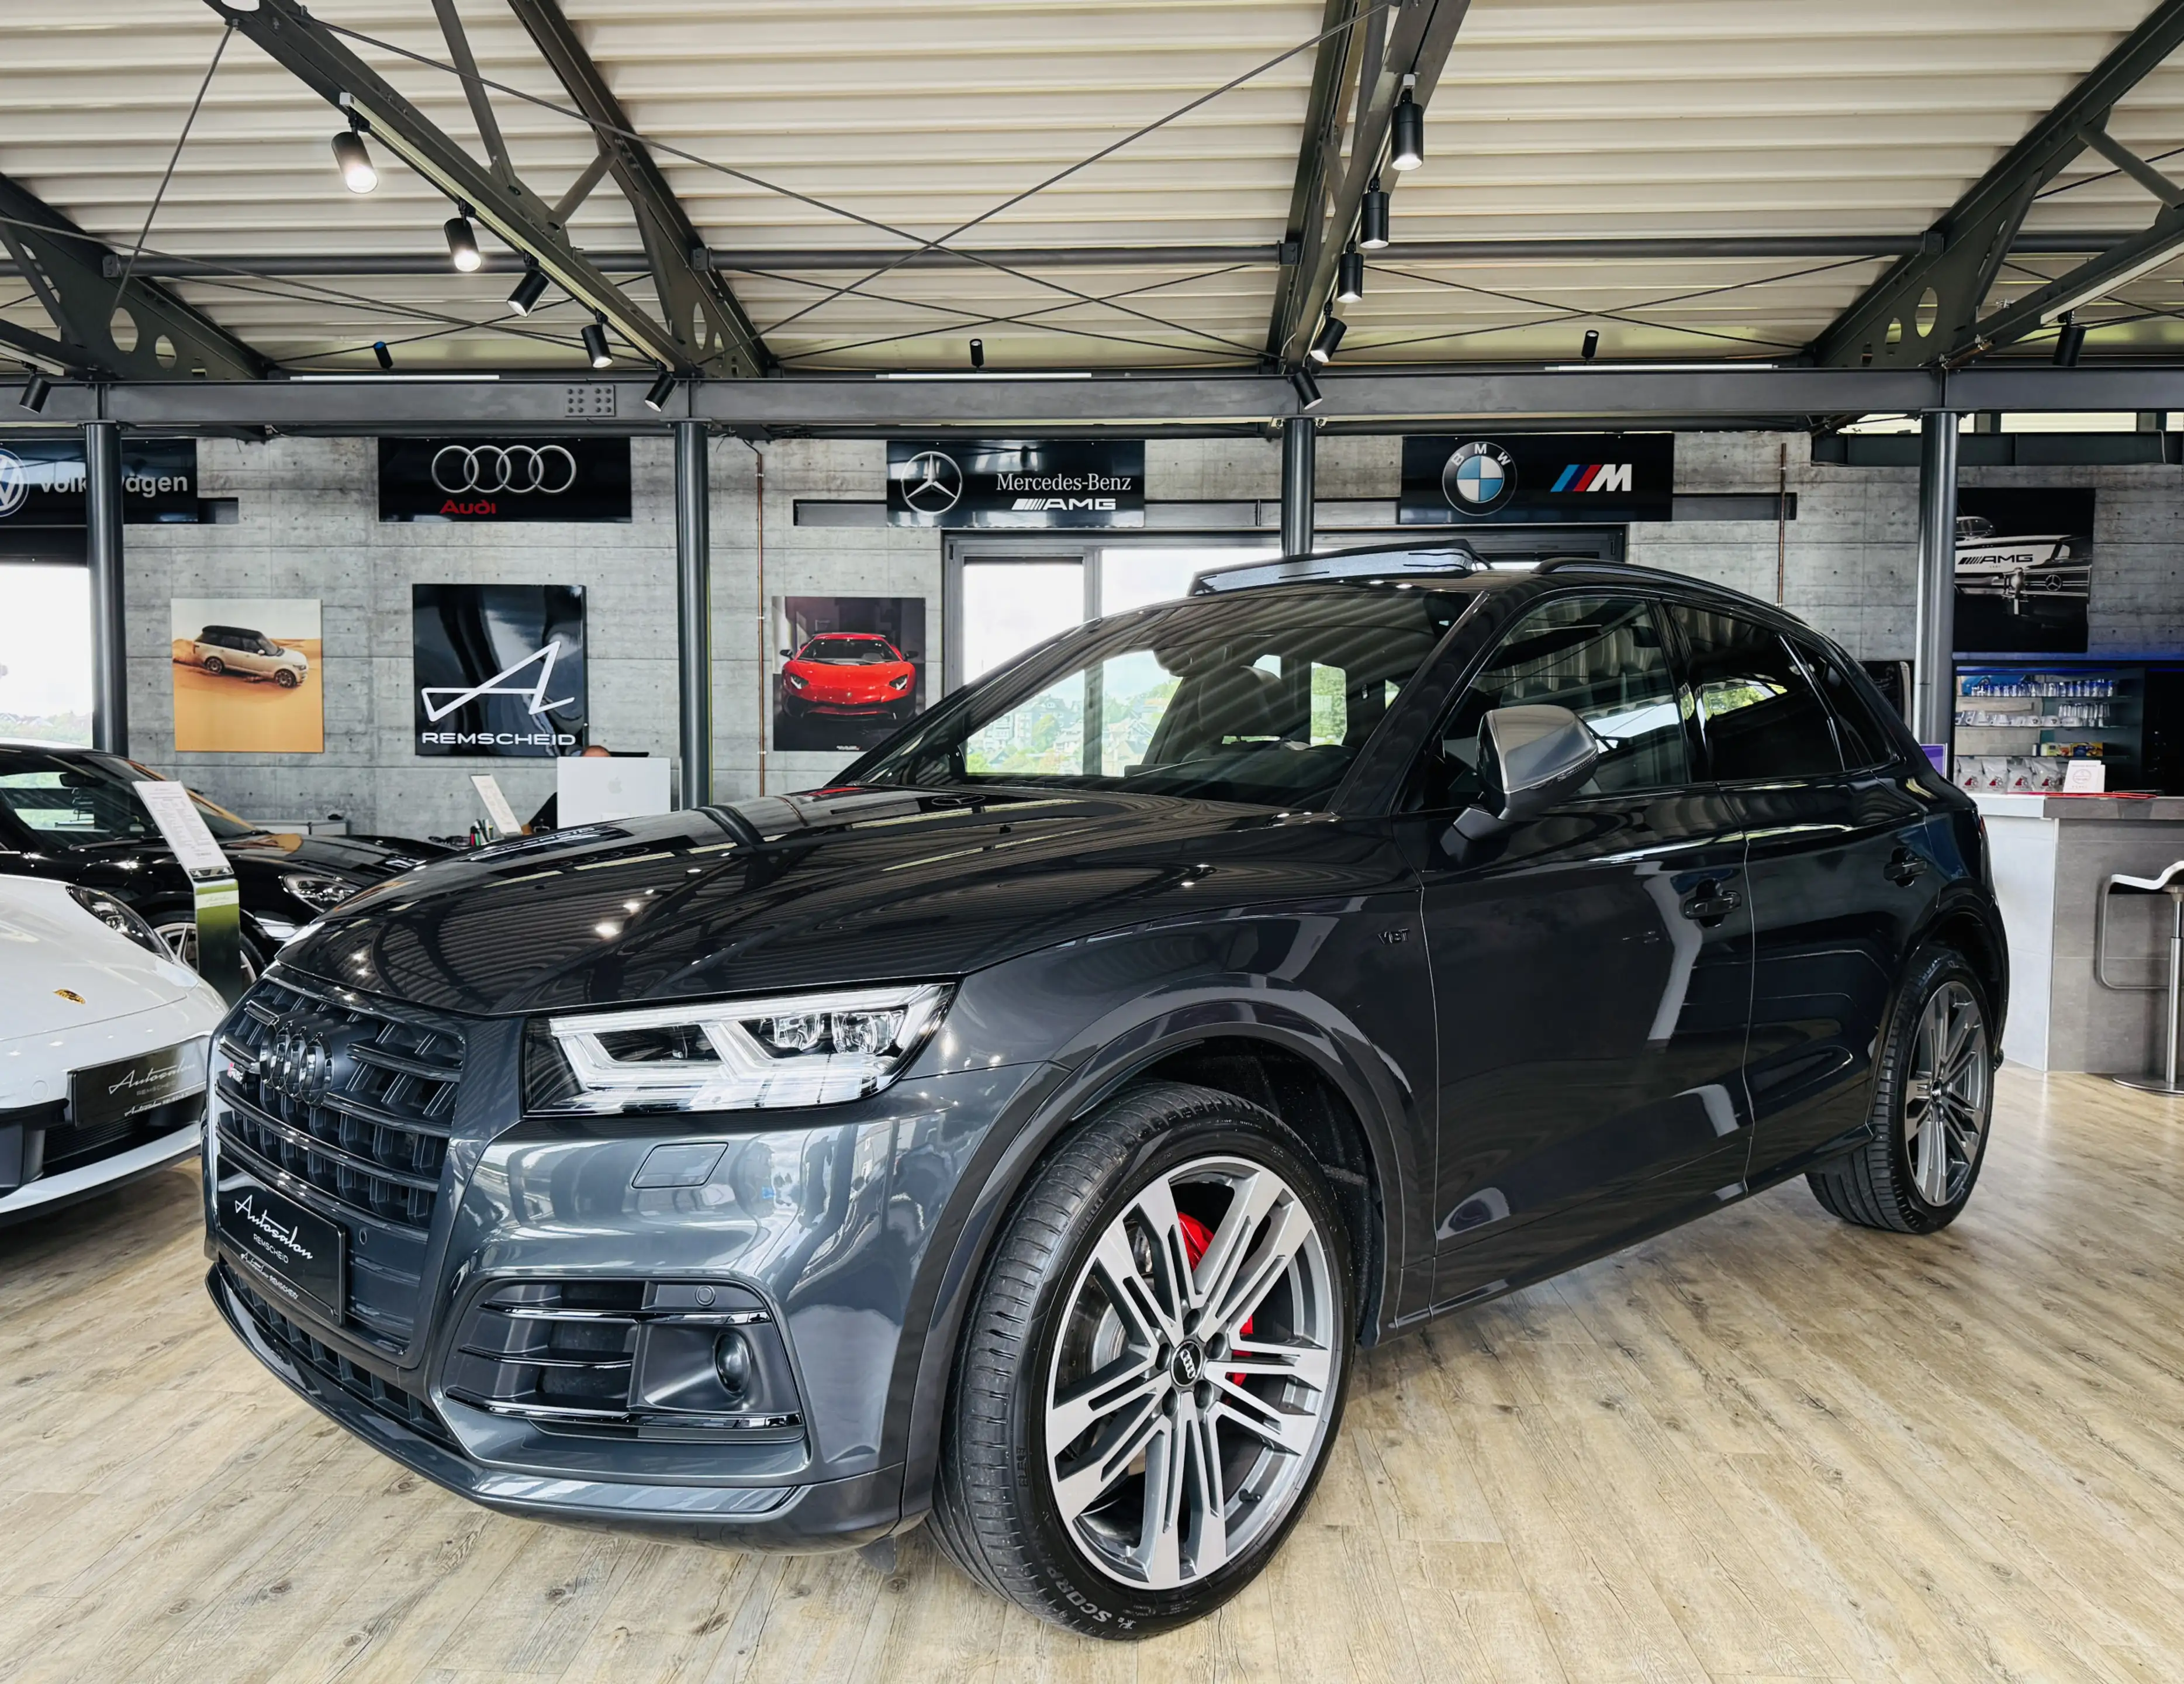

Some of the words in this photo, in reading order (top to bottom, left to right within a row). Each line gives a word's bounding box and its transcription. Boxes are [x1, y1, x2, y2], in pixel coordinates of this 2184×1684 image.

[1451, 443, 1511, 467] BMW
[40, 475, 188, 498] Volkagen
[996, 473, 1131, 491] Mercedes-Benz
[440, 499, 496, 514] Audi
[421, 732, 576, 746] REMSCHEID
[235, 1195, 313, 1259] Autosalon
[253, 1233, 289, 1264] REMSCHEID
